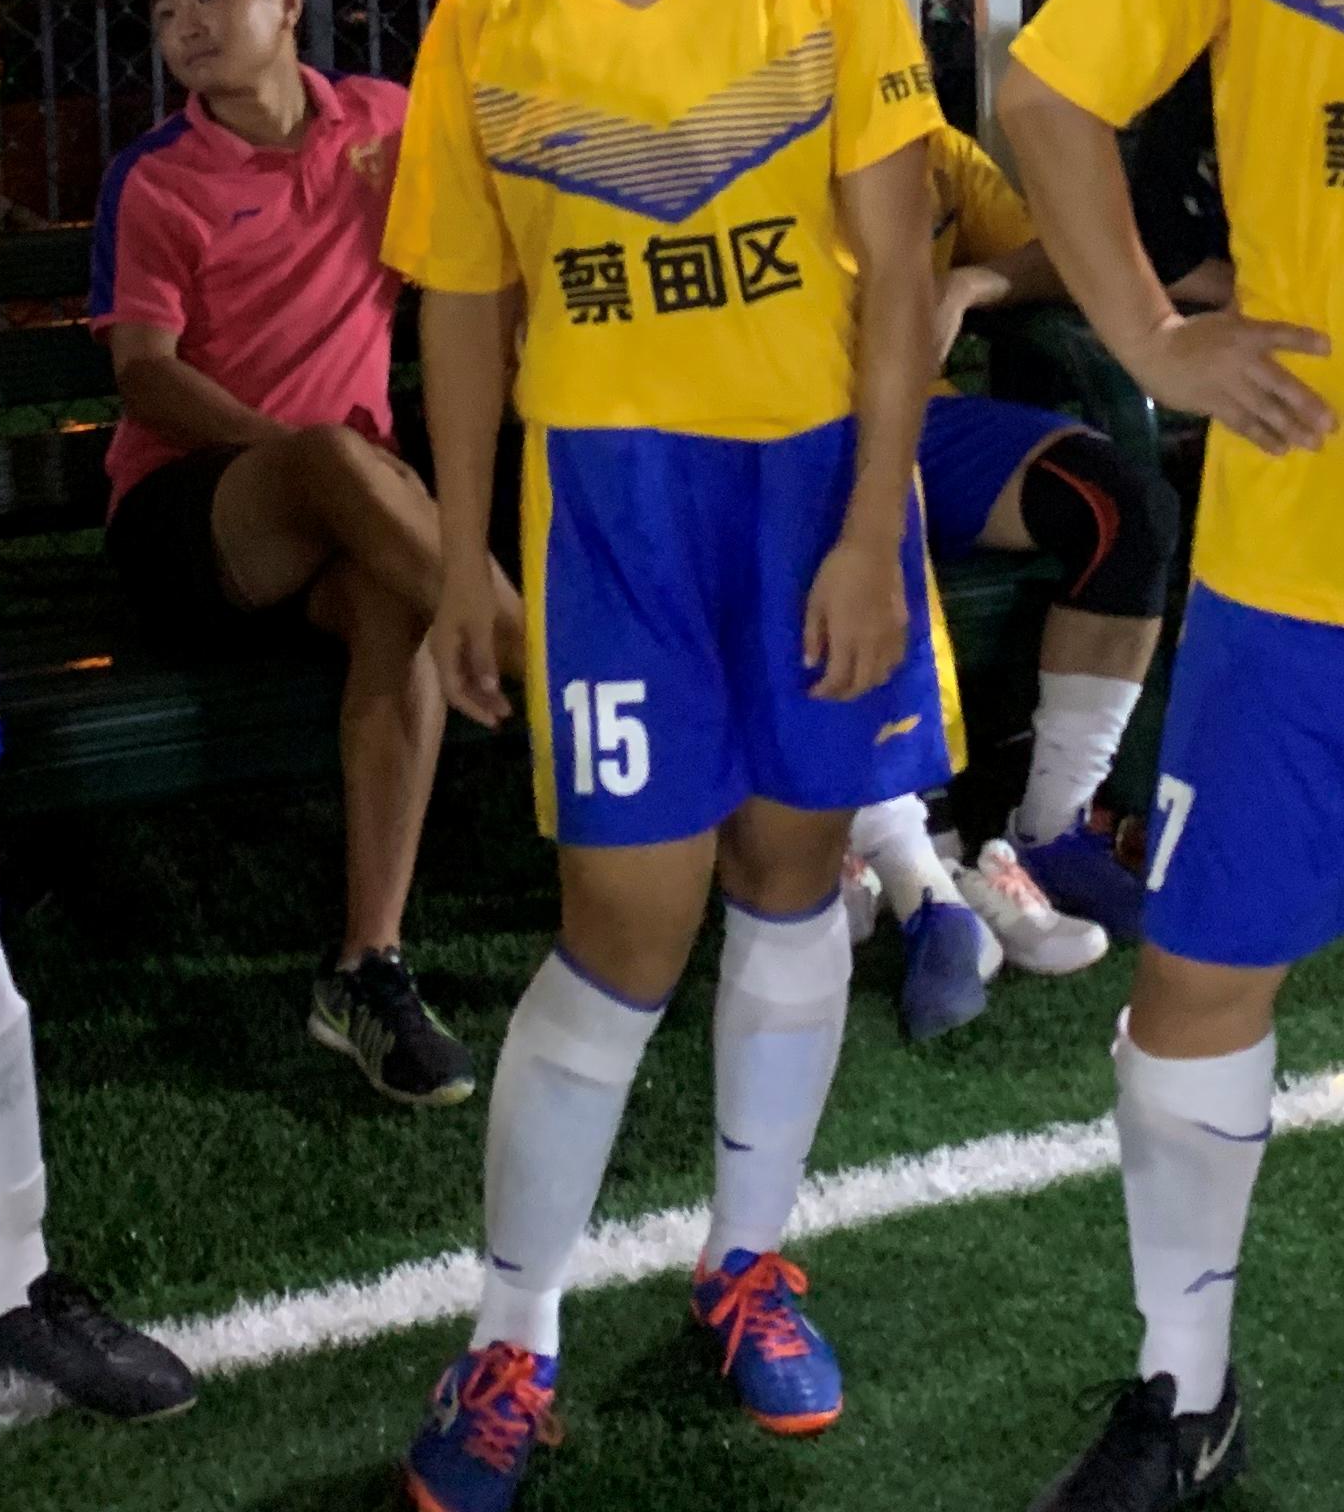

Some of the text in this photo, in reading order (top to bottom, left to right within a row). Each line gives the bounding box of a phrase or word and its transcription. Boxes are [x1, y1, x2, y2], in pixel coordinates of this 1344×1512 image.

[554, 216, 803, 325] 蔡甸区
[563, 678, 651, 797] 15
